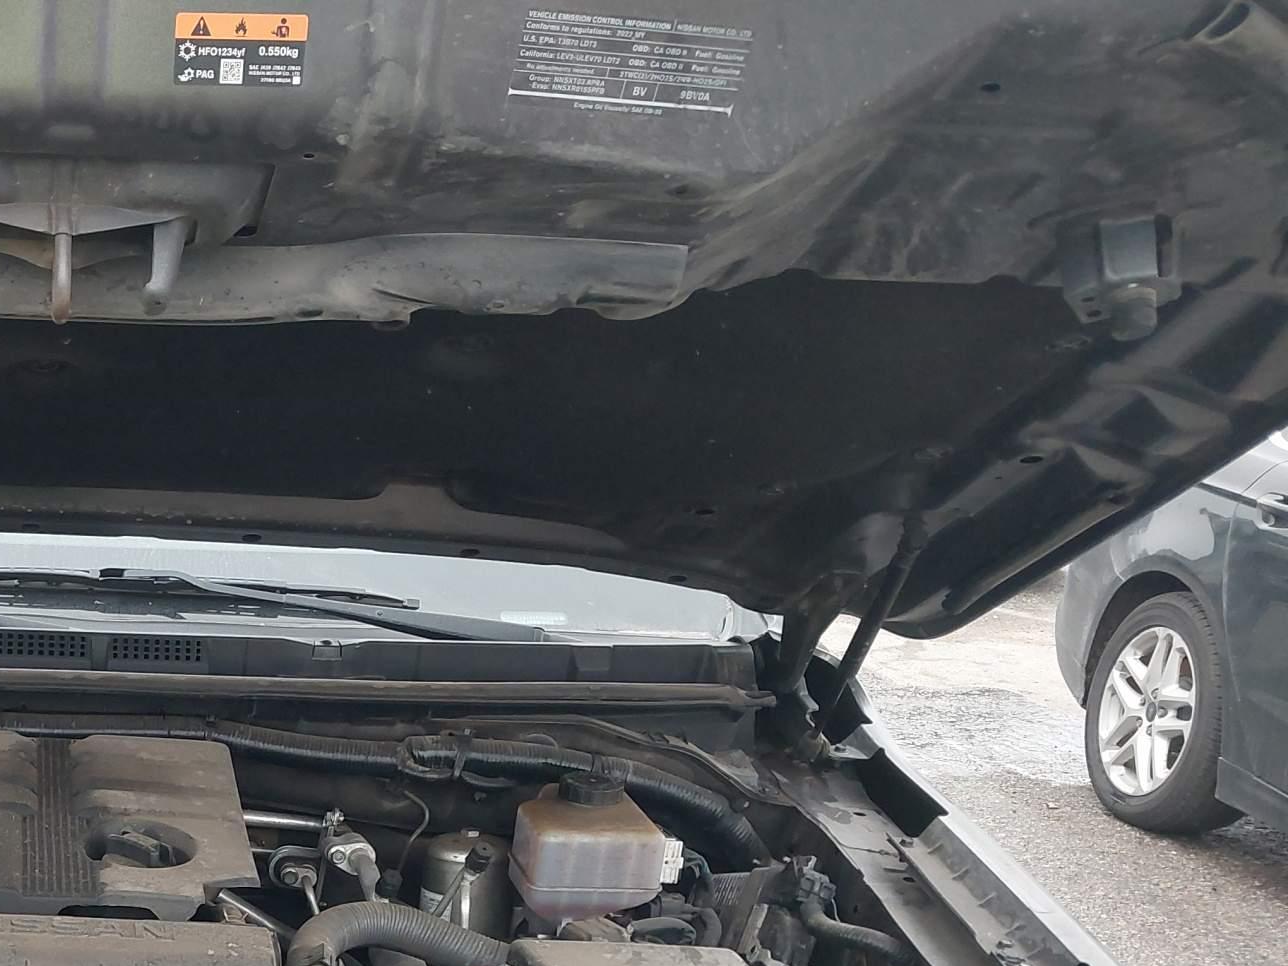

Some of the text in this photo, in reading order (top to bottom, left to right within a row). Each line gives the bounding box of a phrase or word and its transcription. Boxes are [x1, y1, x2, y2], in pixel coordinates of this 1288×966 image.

[528, 10, 672, 30] VEHICLE EMISSION CONTROL INFORMATION
[526, 21, 561, 31] Conforms
[571, 26, 612, 36] regulations:
[523, 34, 537, 43] U.S.
[198, 46, 246, 58] HFO1234yf
[519, 49, 555, 59] California:
[632, 44, 650, 52] OBD:
[653, 46, 664, 54] CA
[665, 48, 681, 56] OBD
[695, 50, 745, 62] Fuel: Gasoline
[628, 58, 647, 67] OBD:
[650, 60, 660, 68] CA
[661, 62, 677, 70] OBD
[691, 64, 741, 76] Fuel: Gasoline
[195, 70, 215, 79] PAG
[632, 86, 648, 97] BV
